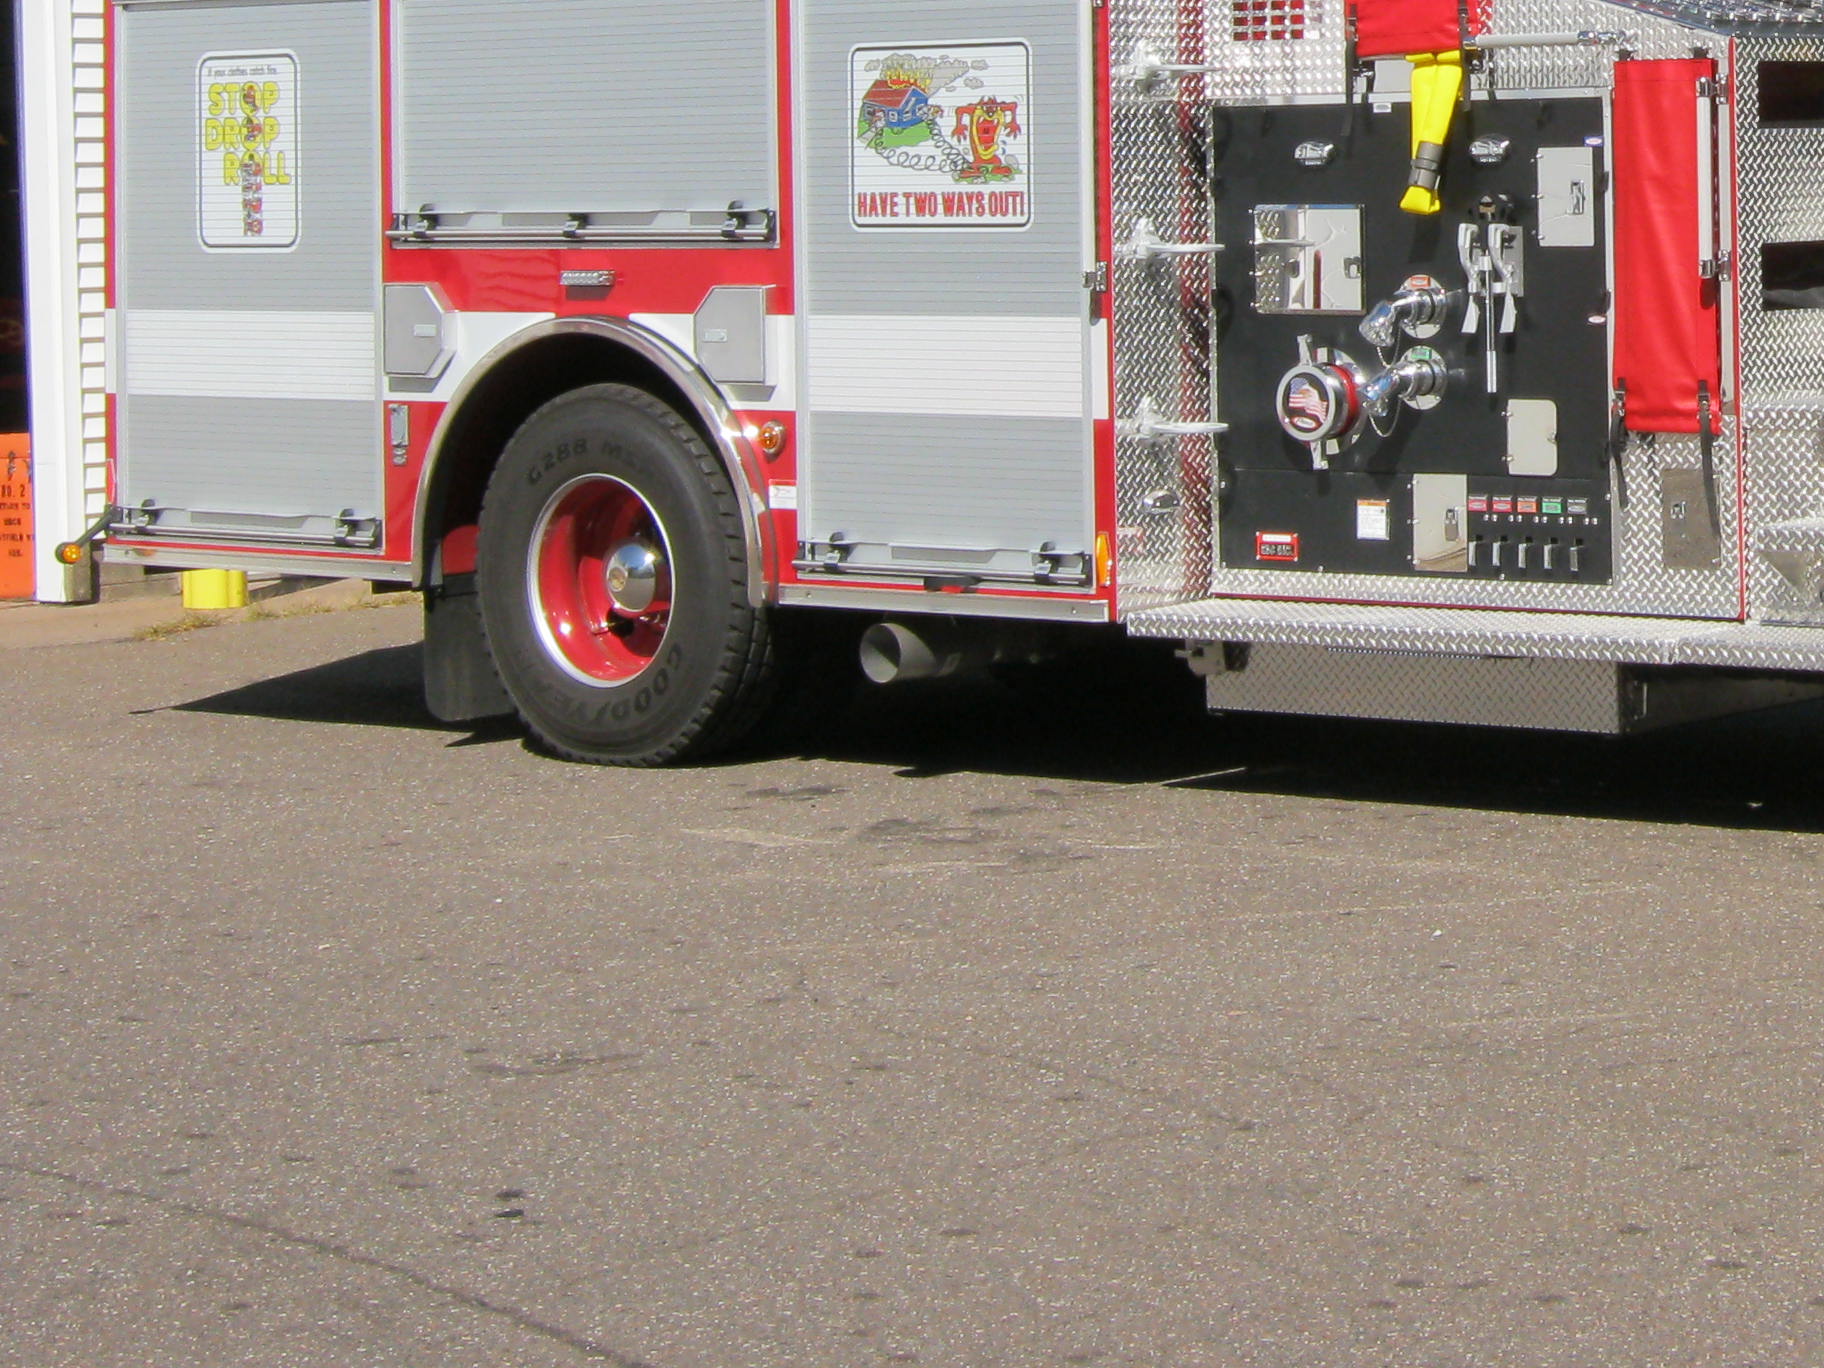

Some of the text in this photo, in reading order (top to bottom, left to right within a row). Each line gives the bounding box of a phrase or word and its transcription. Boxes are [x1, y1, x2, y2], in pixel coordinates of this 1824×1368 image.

[207, 81, 280, 116] STOP
[204, 116, 280, 151] DROP
[223, 149, 292, 185] ROLL
[857, 190, 1025, 217] HAVE TWO WAYS OUT!
[529, 437, 588, 484] G288
[20, 484, 26, 498] 2
